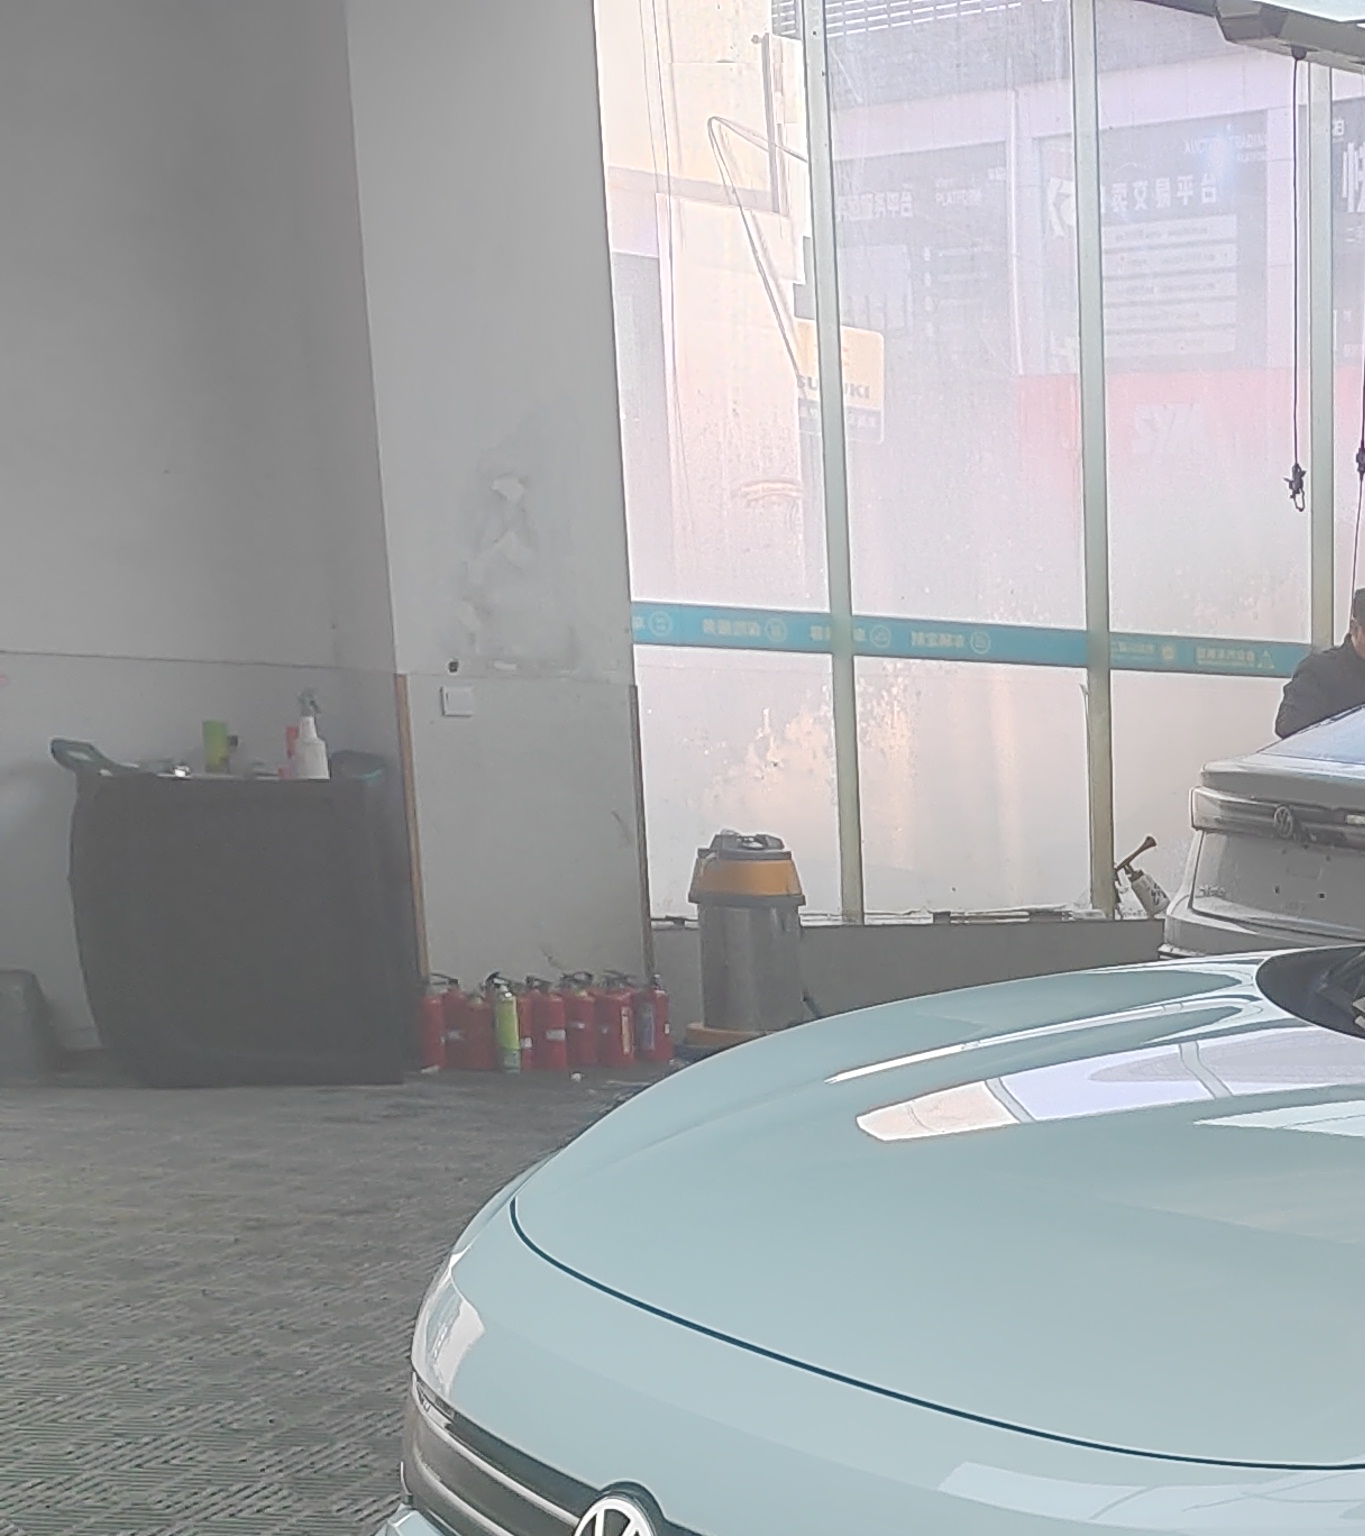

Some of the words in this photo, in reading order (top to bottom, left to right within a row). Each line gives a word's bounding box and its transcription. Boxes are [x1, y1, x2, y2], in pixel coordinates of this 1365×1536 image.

[1100, 173, 1217, 213] 卖交易平台
